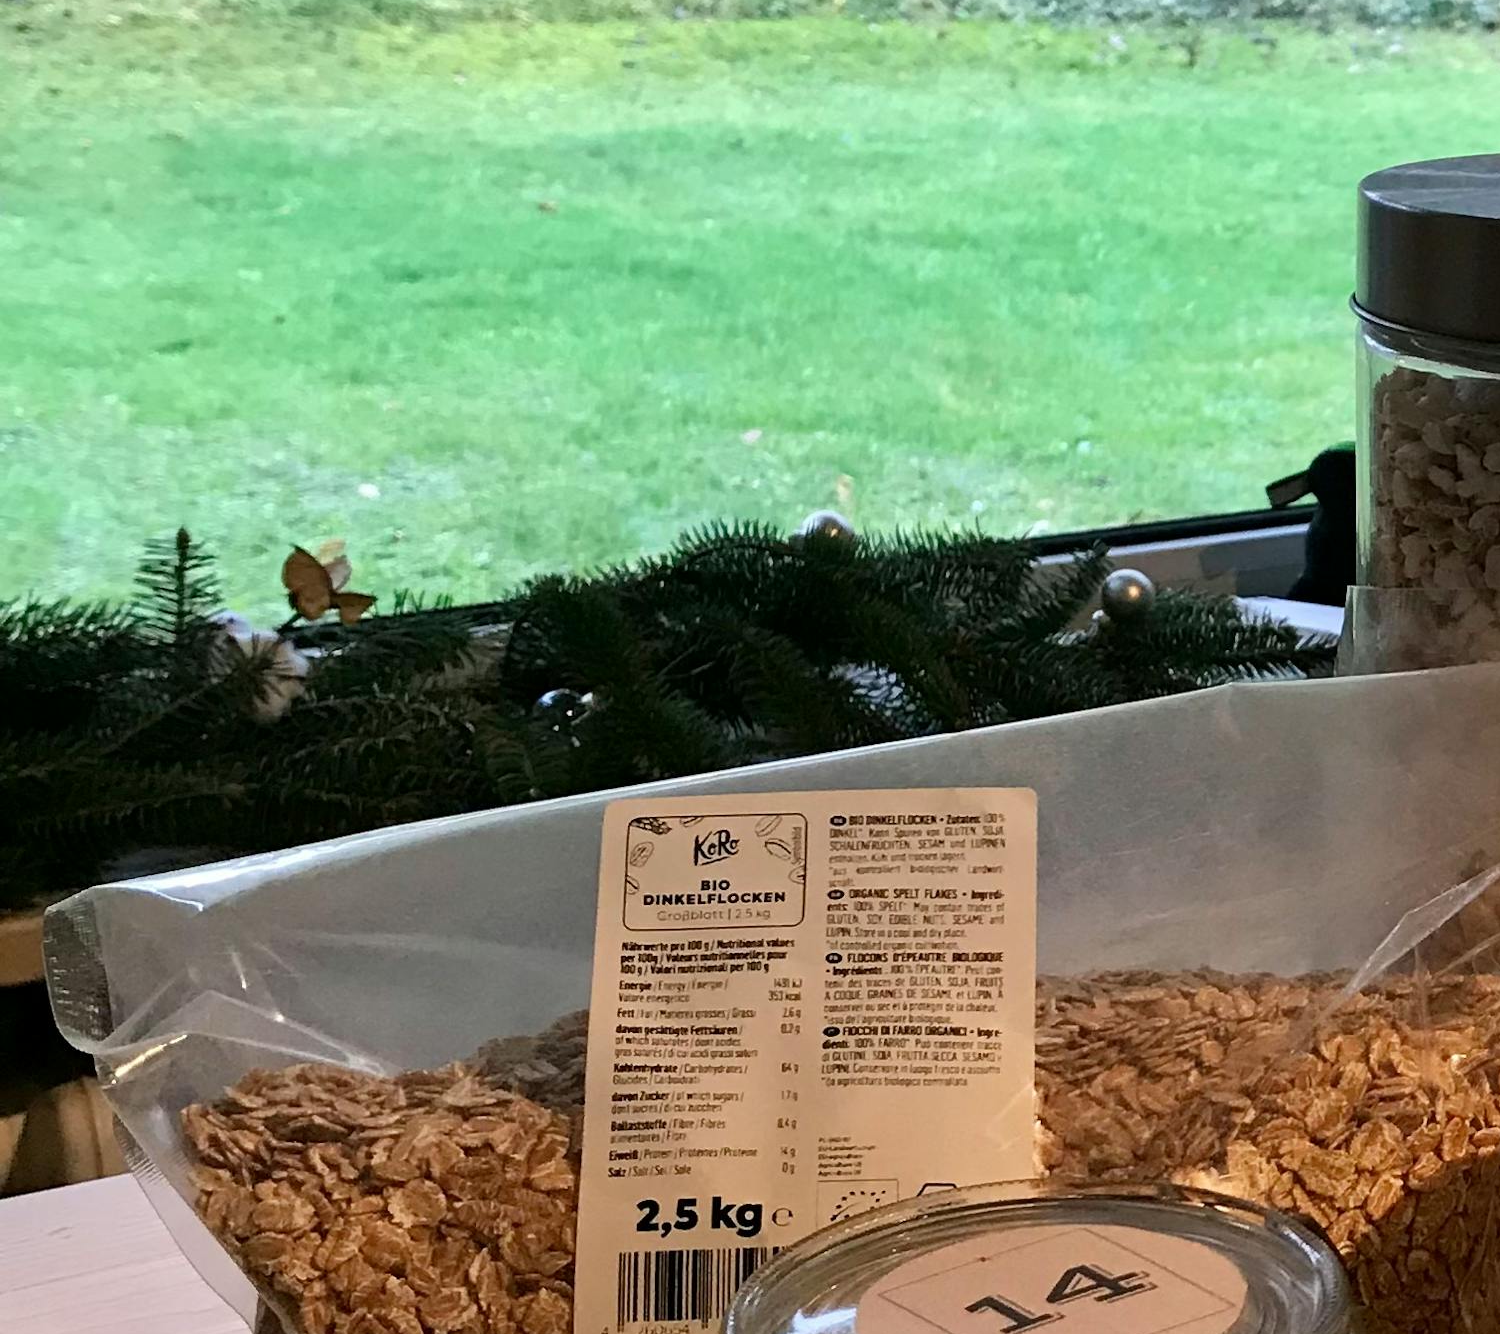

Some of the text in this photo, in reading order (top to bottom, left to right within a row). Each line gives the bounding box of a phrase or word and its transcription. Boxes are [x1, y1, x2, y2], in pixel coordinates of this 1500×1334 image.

[694, 830, 740, 865] KoRo
[701, 880, 730, 890] BIO
[644, 892, 786, 905] DINKELFLOCKEN
[850, 889, 957, 898] ORGANIC SPELT FLAKES
[657, 909, 723, 921] Großblatt
[847, 953, 887, 963] FLOCONS
[620, 981, 652, 990] Energie
[608, 1168, 626, 1177] Salz
[636, 1196, 763, 1238] 2,5 kg
[965, 1264, 1158, 1334] 14
